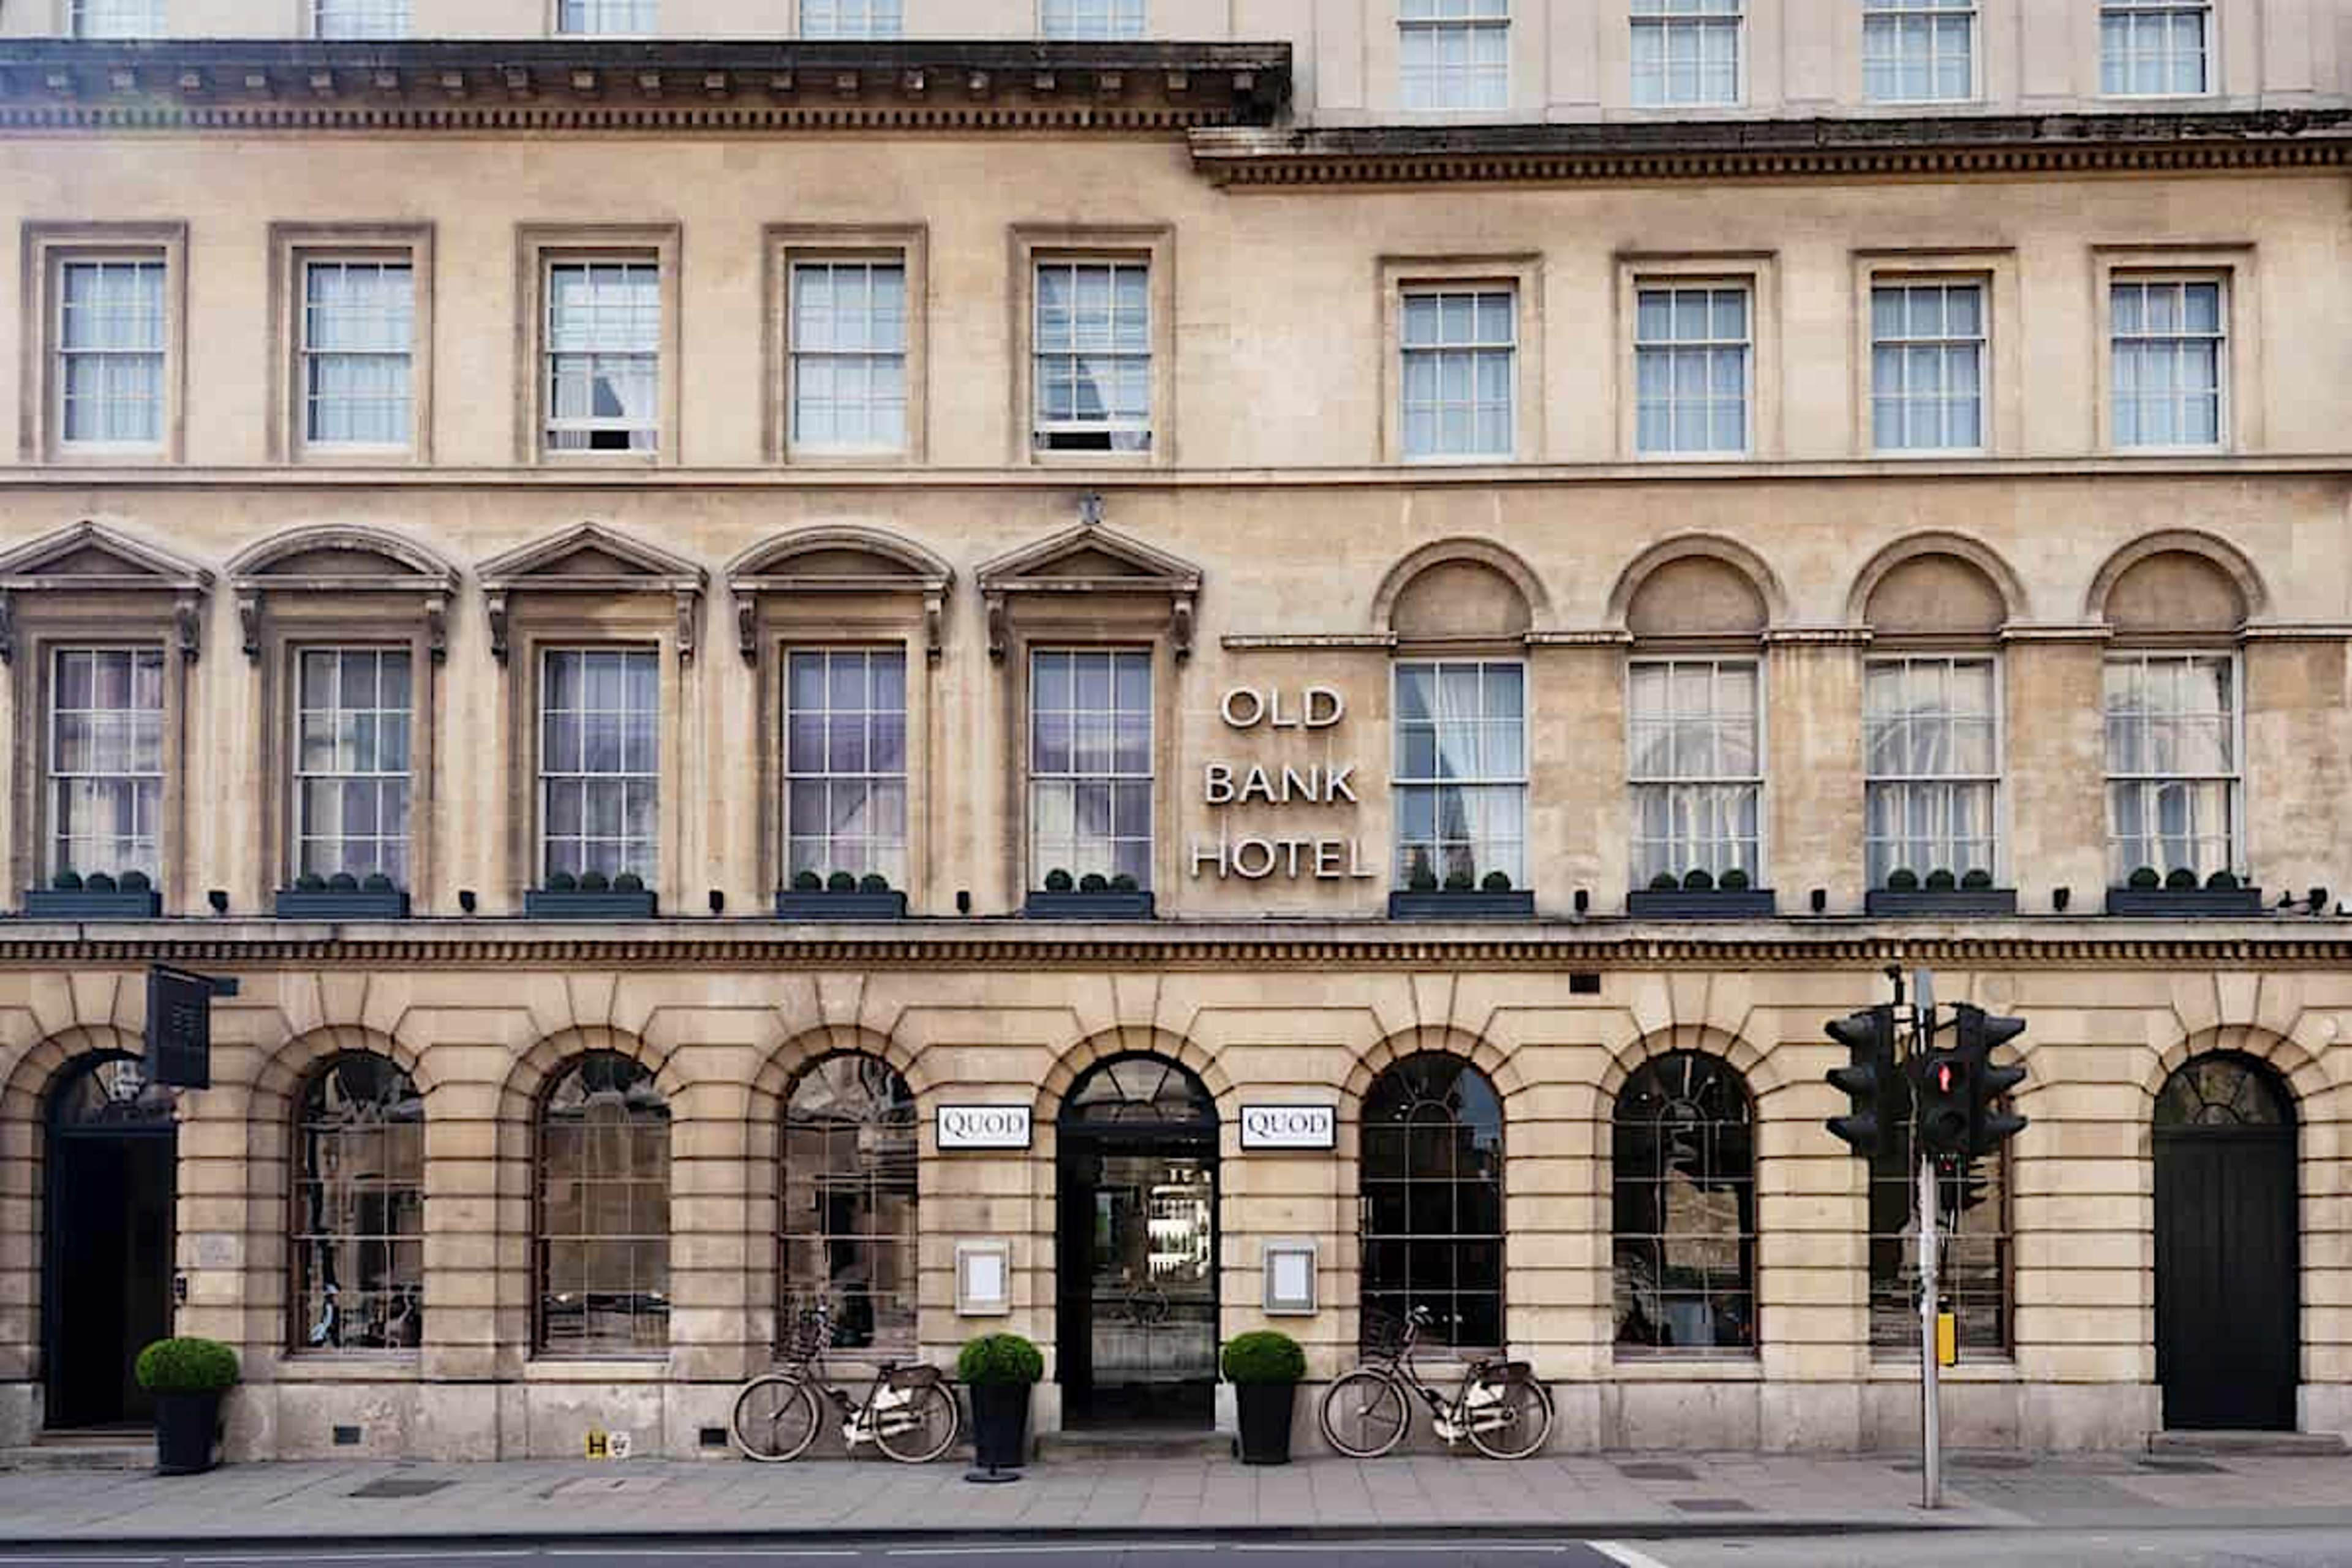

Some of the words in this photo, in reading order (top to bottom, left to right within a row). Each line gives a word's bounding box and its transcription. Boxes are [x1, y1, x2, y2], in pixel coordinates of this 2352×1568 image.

[1222, 685, 1344, 727] OLD
[1205, 764, 1358, 804] BANK
[1191, 835, 1376, 879] HOTEL
[944, 1111, 1025, 1139] QUOD
[1247, 1111, 1327, 1139] QUOD
[589, 1431, 606, 1455] H
